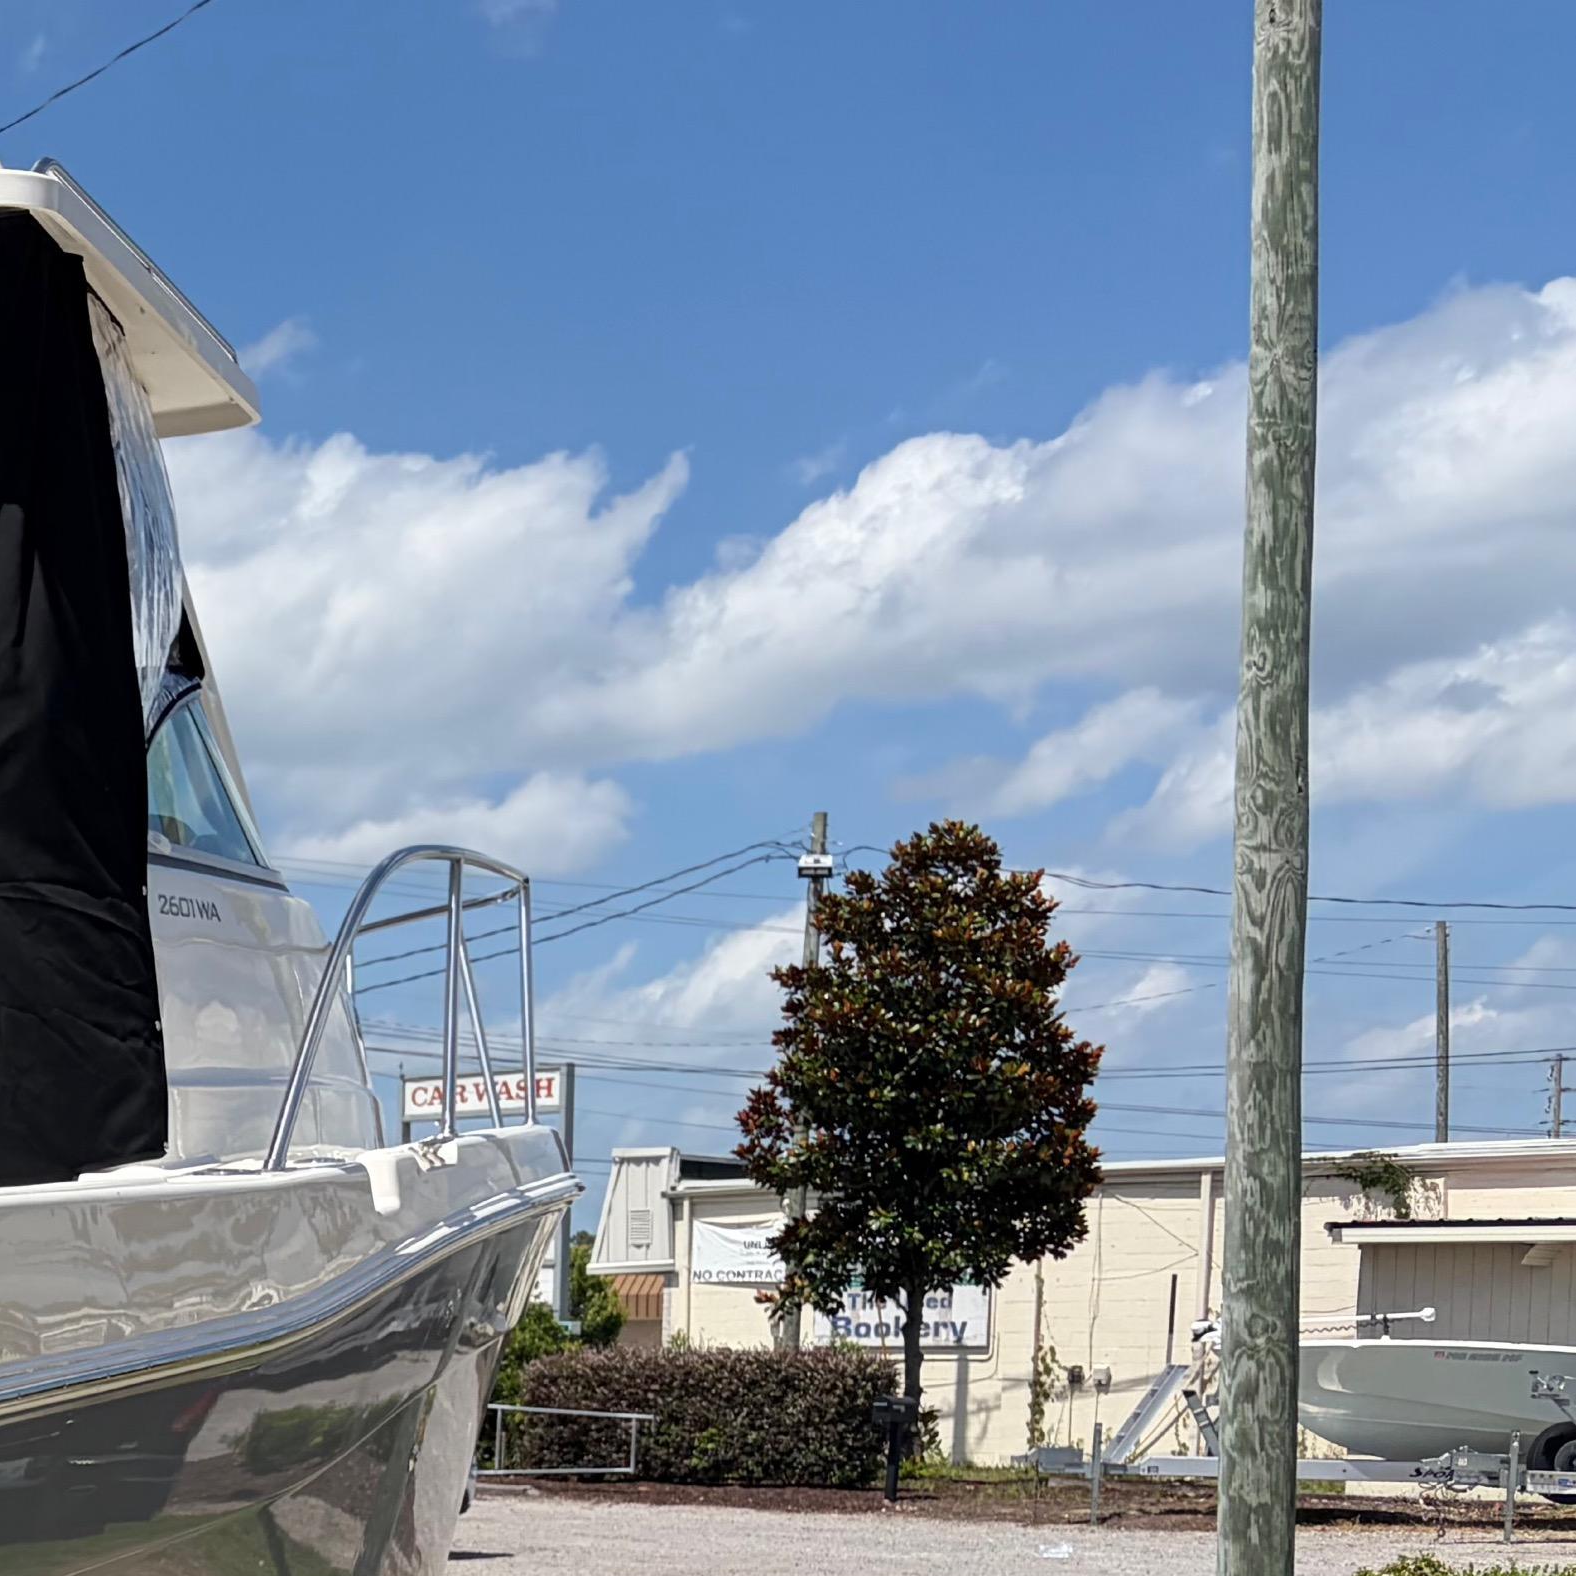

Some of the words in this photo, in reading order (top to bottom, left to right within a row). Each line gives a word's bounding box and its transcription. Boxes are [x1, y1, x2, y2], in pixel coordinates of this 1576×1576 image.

[158, 894, 221, 922] 2601WA
[693, 1269, 713, 1281] NO
[716, 1269, 783, 1281] CONTRAC
